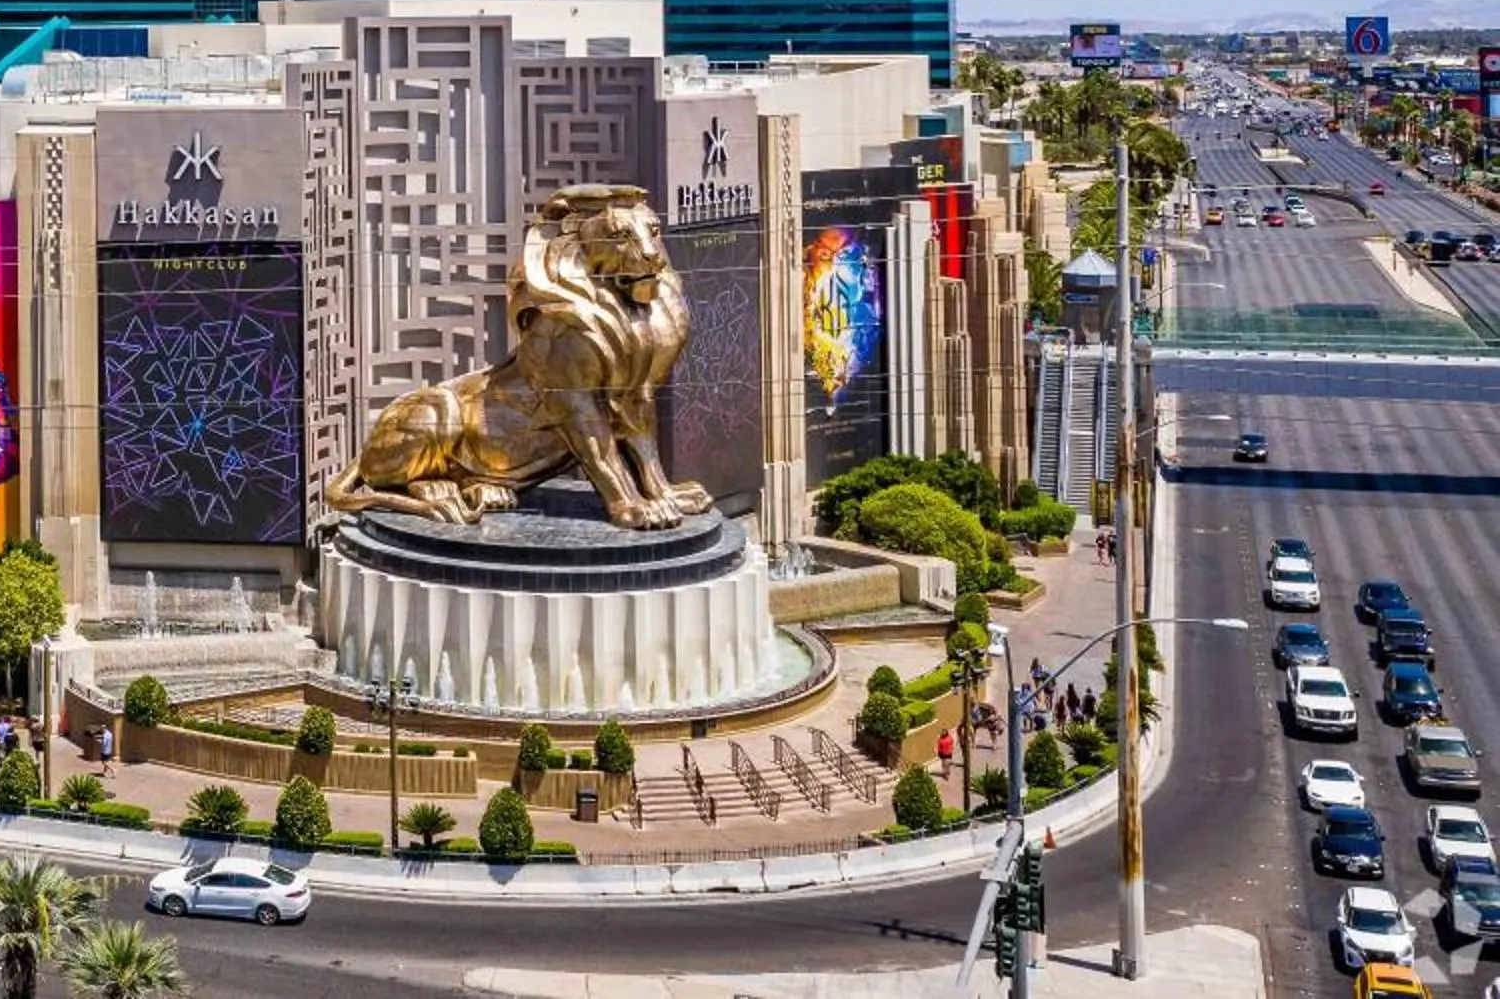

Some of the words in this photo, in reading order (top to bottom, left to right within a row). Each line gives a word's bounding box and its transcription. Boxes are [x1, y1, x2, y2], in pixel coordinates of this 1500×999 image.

[1353, 19, 1383, 56] 6
[117, 200, 279, 225] Hakkasan
[153, 258, 248, 270] NIGHTCLUB
